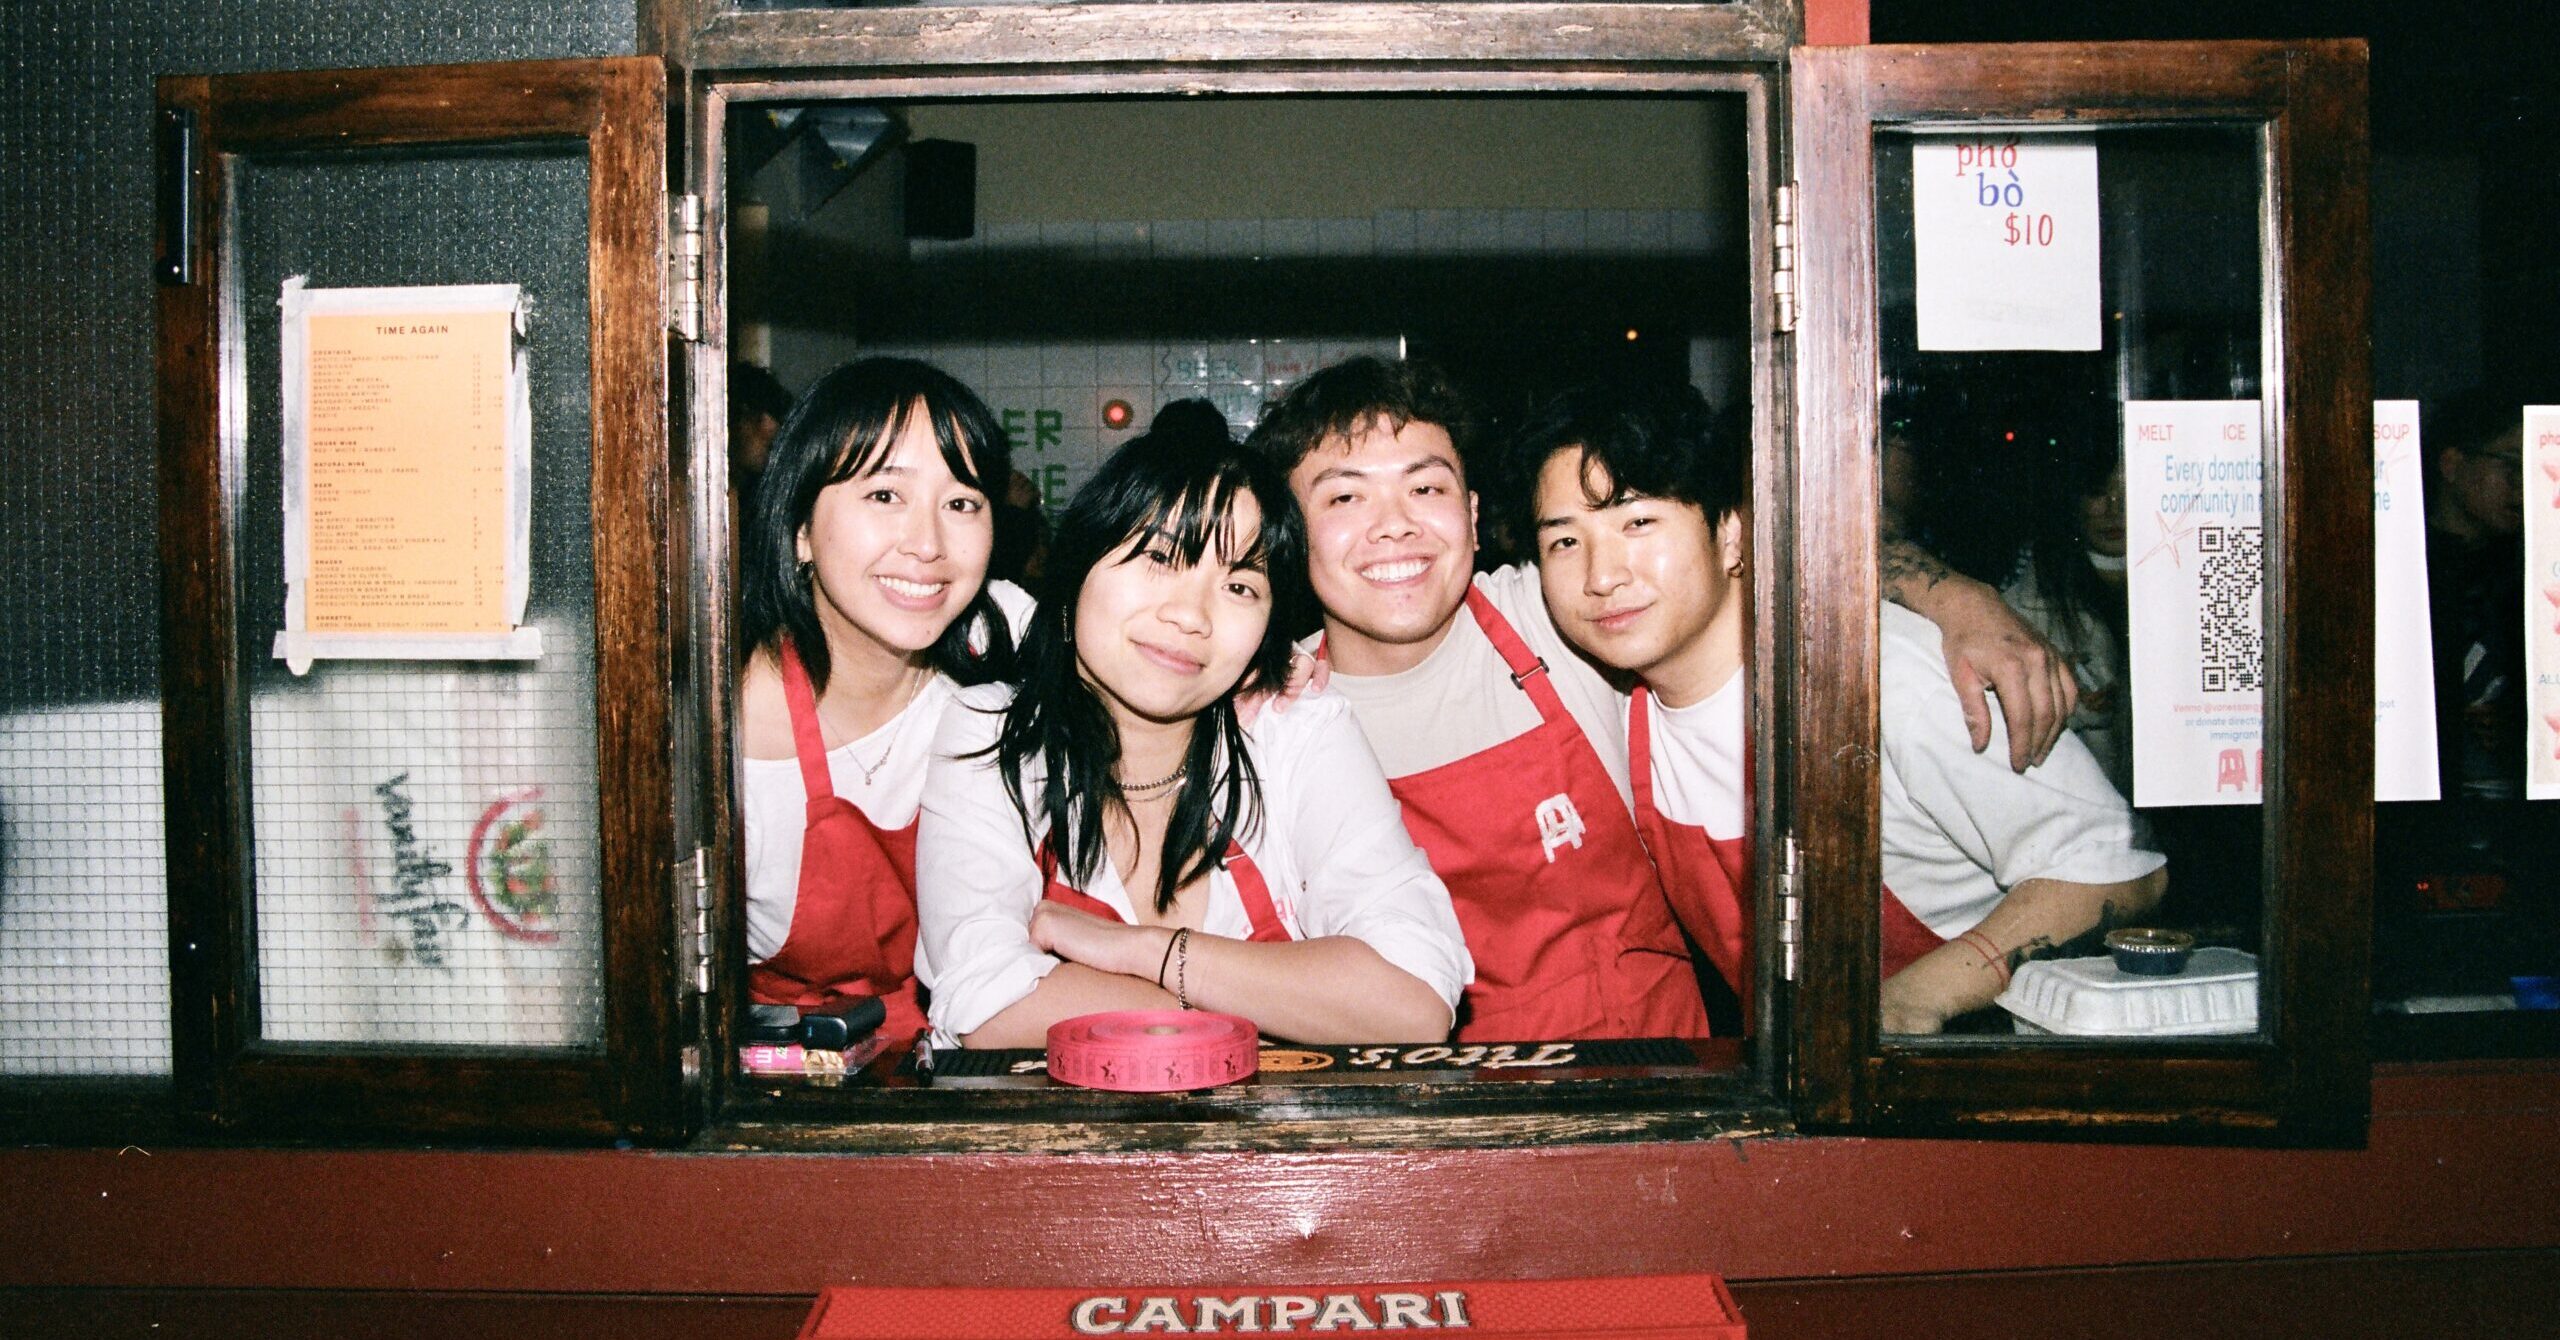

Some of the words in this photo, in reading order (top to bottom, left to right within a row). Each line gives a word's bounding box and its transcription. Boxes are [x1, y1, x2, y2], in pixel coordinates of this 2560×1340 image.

[1976, 168, 2023, 208] bò
[2003, 211, 2054, 247] $10
[376, 325, 406, 336] TIME
[410, 324, 450, 335] AGAIN
[2138, 424, 2174, 441] MELT
[2223, 423, 2247, 441] ICE
[2165, 454, 2204, 486] Every
[2161, 486, 2238, 519] community
[2242, 485, 2254, 513] in
[2209, 731, 2259, 742] immigrant
[1350, 1043, 1577, 1069] Tito's
[1073, 1291, 1471, 1335] CAMPARI
